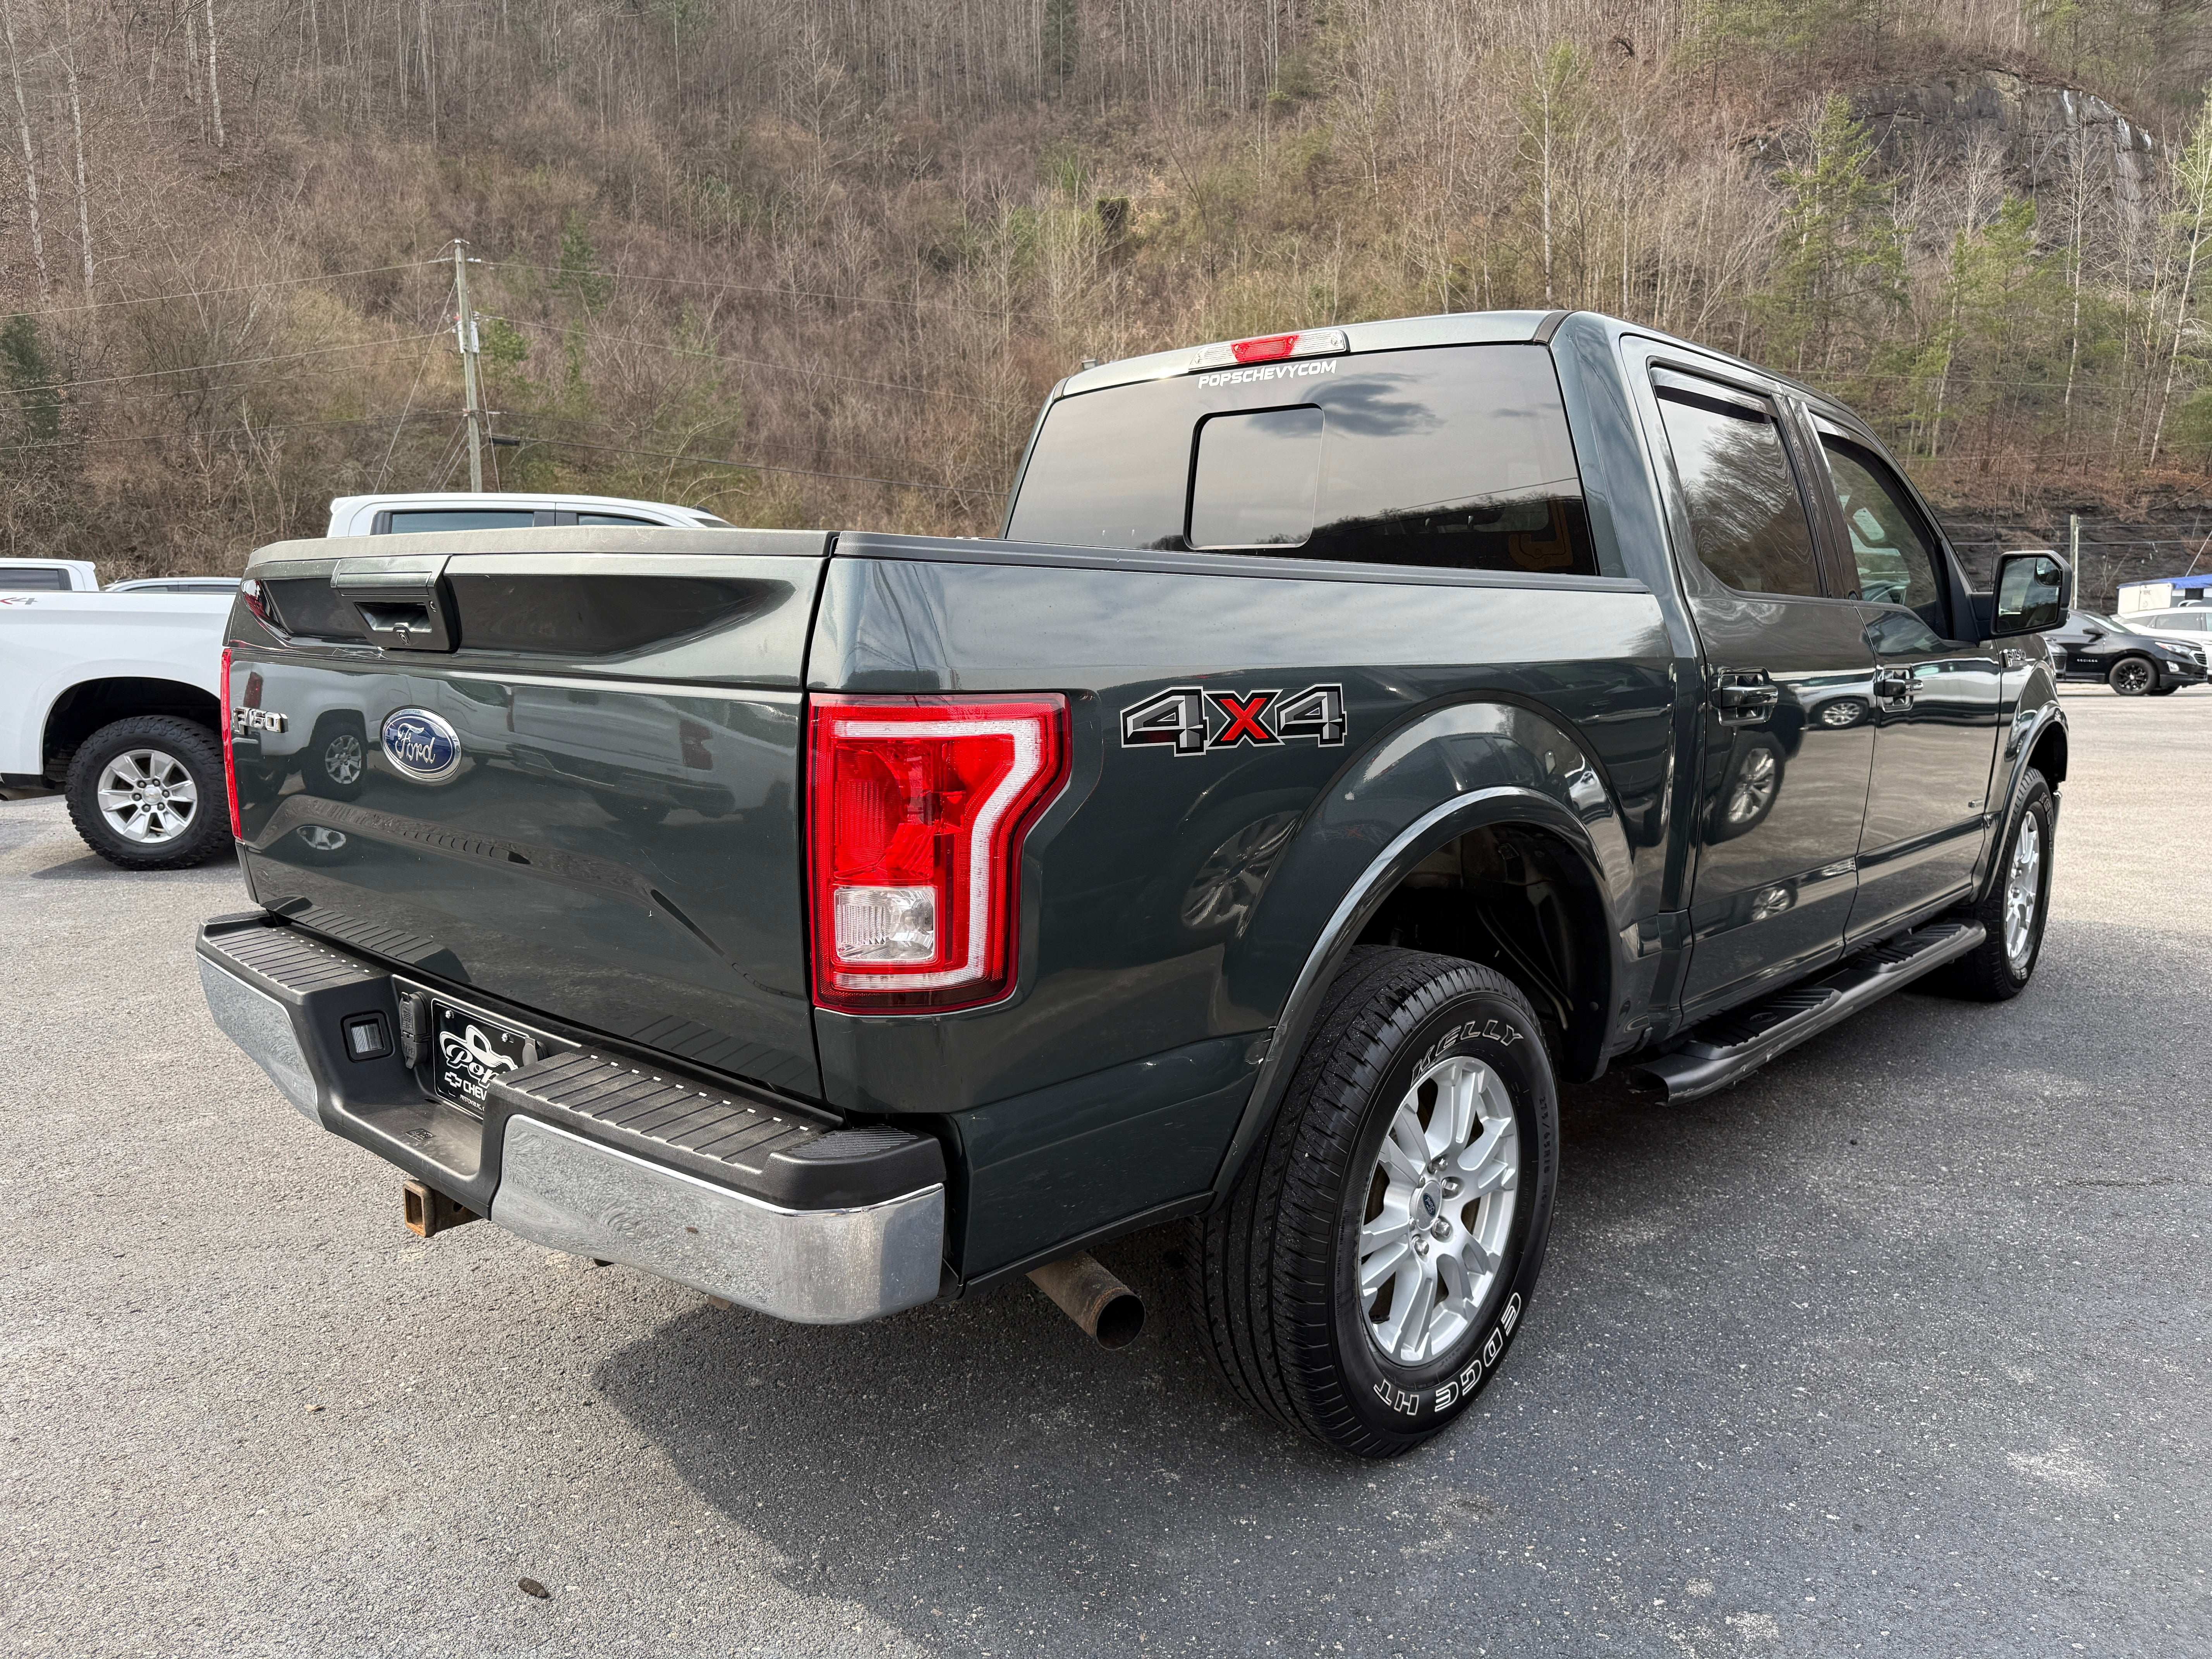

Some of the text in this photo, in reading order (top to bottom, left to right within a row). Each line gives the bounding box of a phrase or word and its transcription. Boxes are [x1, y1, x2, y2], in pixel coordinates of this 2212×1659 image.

[395, 723, 436, 764] Ford
[1410, 1019, 1524, 1089] KELLY
[1373, 1292, 1522, 1416] EDGE HT
